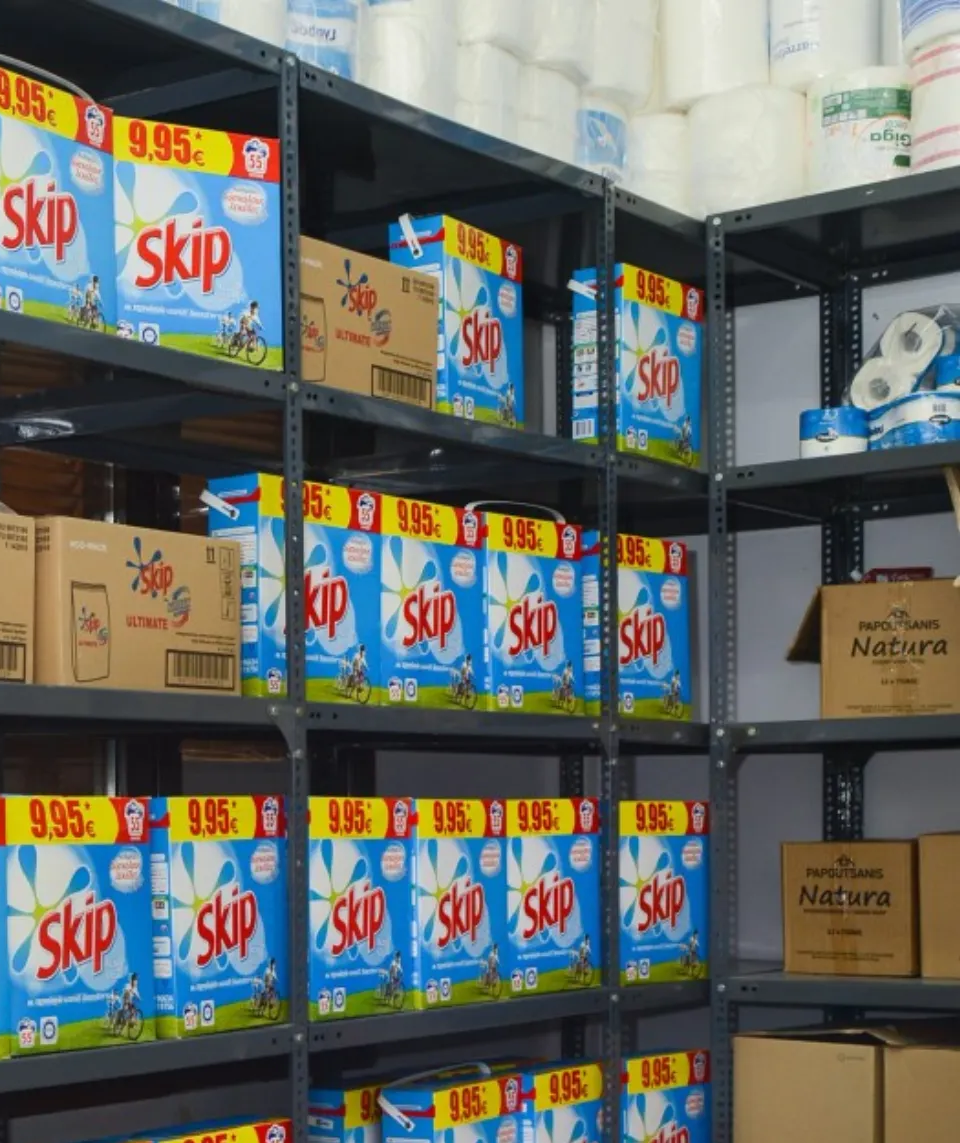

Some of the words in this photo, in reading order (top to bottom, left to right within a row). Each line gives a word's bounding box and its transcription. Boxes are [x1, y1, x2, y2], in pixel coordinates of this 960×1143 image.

[1, 178, 78, 263] Skip
[135, 217, 232, 294] Skip
[347, 283, 379, 319] Skip
[334, 327, 373, 347] ULTIMATE
[460, 308, 501, 373] Skip
[637, 350, 680, 407] Skip
[140, 560, 174, 596] Skip
[302, 566, 349, 639] kip
[126, 614, 169, 631] ULTIMATE
[402, 583, 456, 649] Skip
[508, 595, 558, 657] Skip
[619, 607, 666, 666] Skip
[849, 635, 949, 658] Natura
[522, 871, 575, 940] Skip
[637, 867, 686, 933] Skip
[798, 884, 892, 907] Natura
[806, 868, 884, 879] PAPOUTSANIS
[36, 892, 118, 980] Skip
[195, 885, 258, 967] Skip
[332, 881, 385, 956] Skip
[436, 876, 485, 948] Skip
